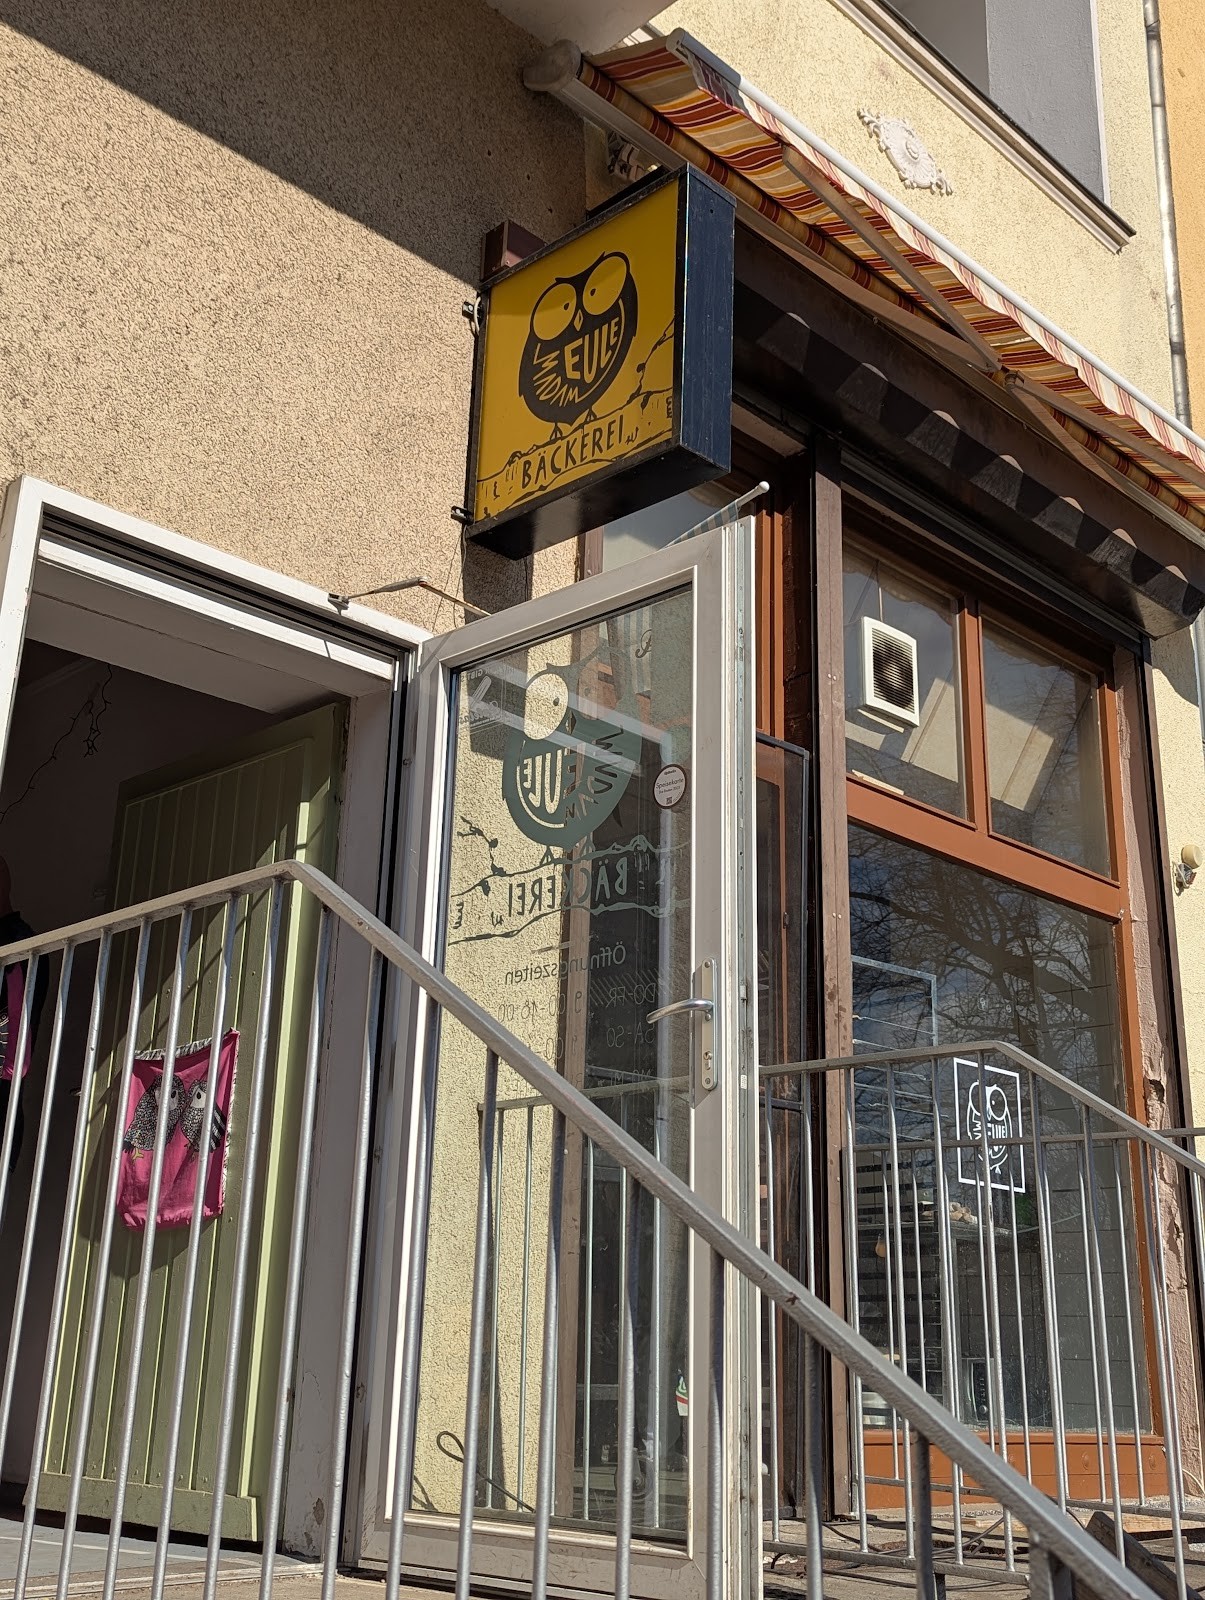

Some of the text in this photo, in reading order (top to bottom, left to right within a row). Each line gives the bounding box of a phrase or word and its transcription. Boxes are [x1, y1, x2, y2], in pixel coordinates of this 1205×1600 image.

[564, 316, 620, 384] EULE
[521, 414, 624, 490] BÄCKEREI
[656, 778, 684, 790] Speisekarte
